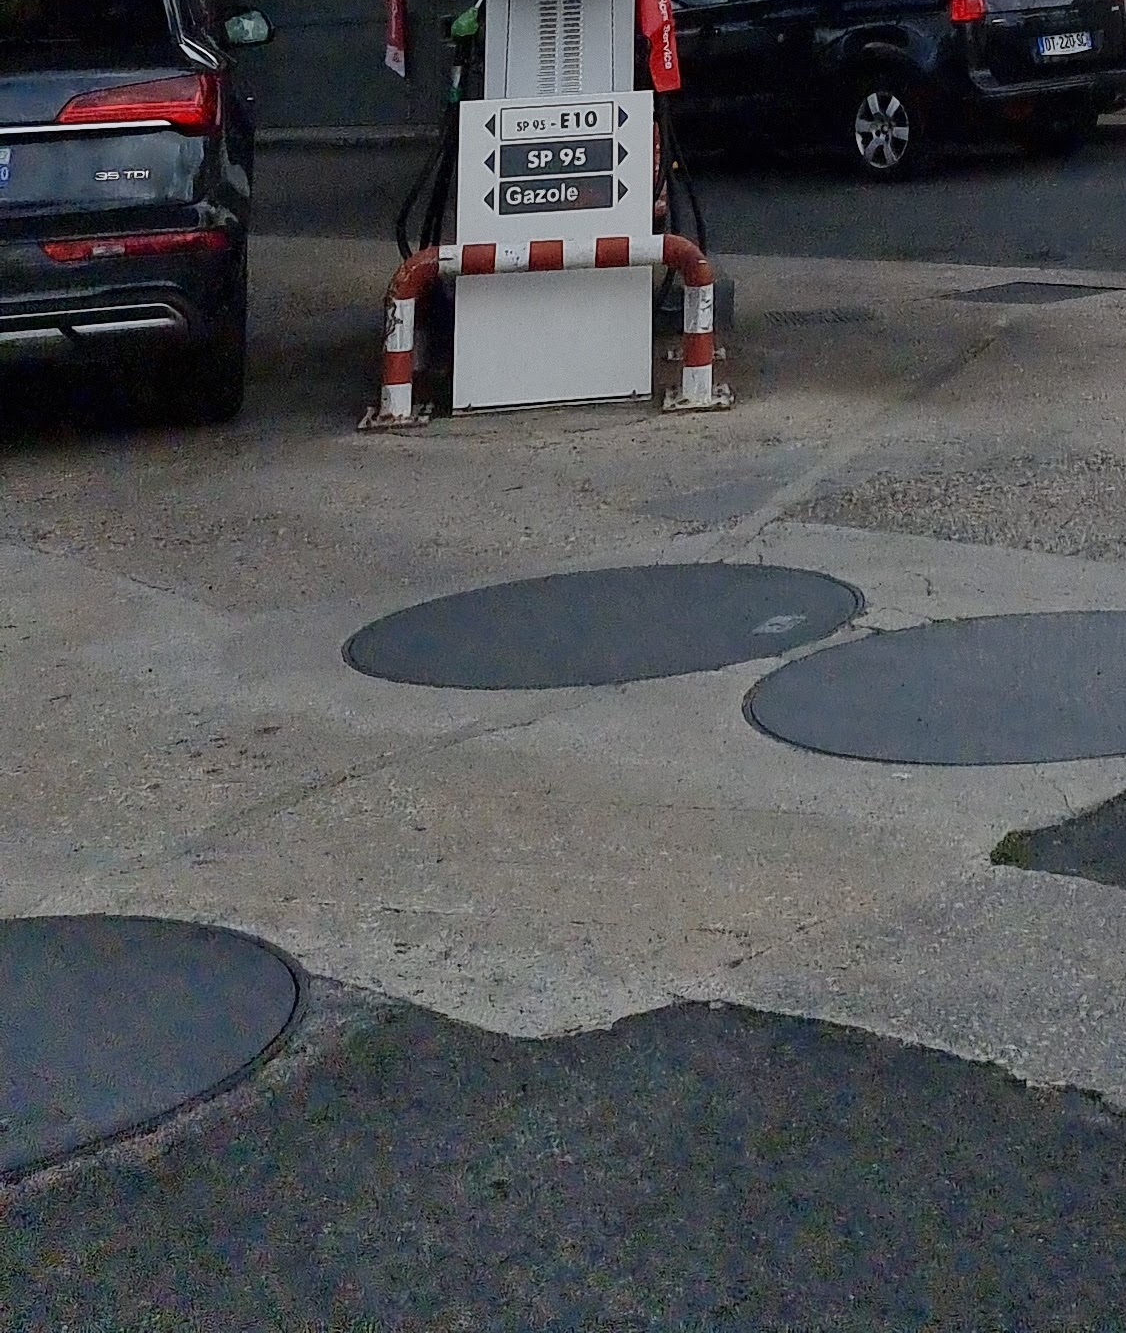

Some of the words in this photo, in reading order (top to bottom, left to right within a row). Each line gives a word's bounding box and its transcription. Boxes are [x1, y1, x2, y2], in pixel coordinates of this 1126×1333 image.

[516, 121, 530, 132] SP
[560, 110, 598, 129] E10
[527, 150, 553, 169] SP
[559, 148, 588, 167] 95
[94, 171, 120, 182] 35
[505, 182, 580, 206] Gazole
